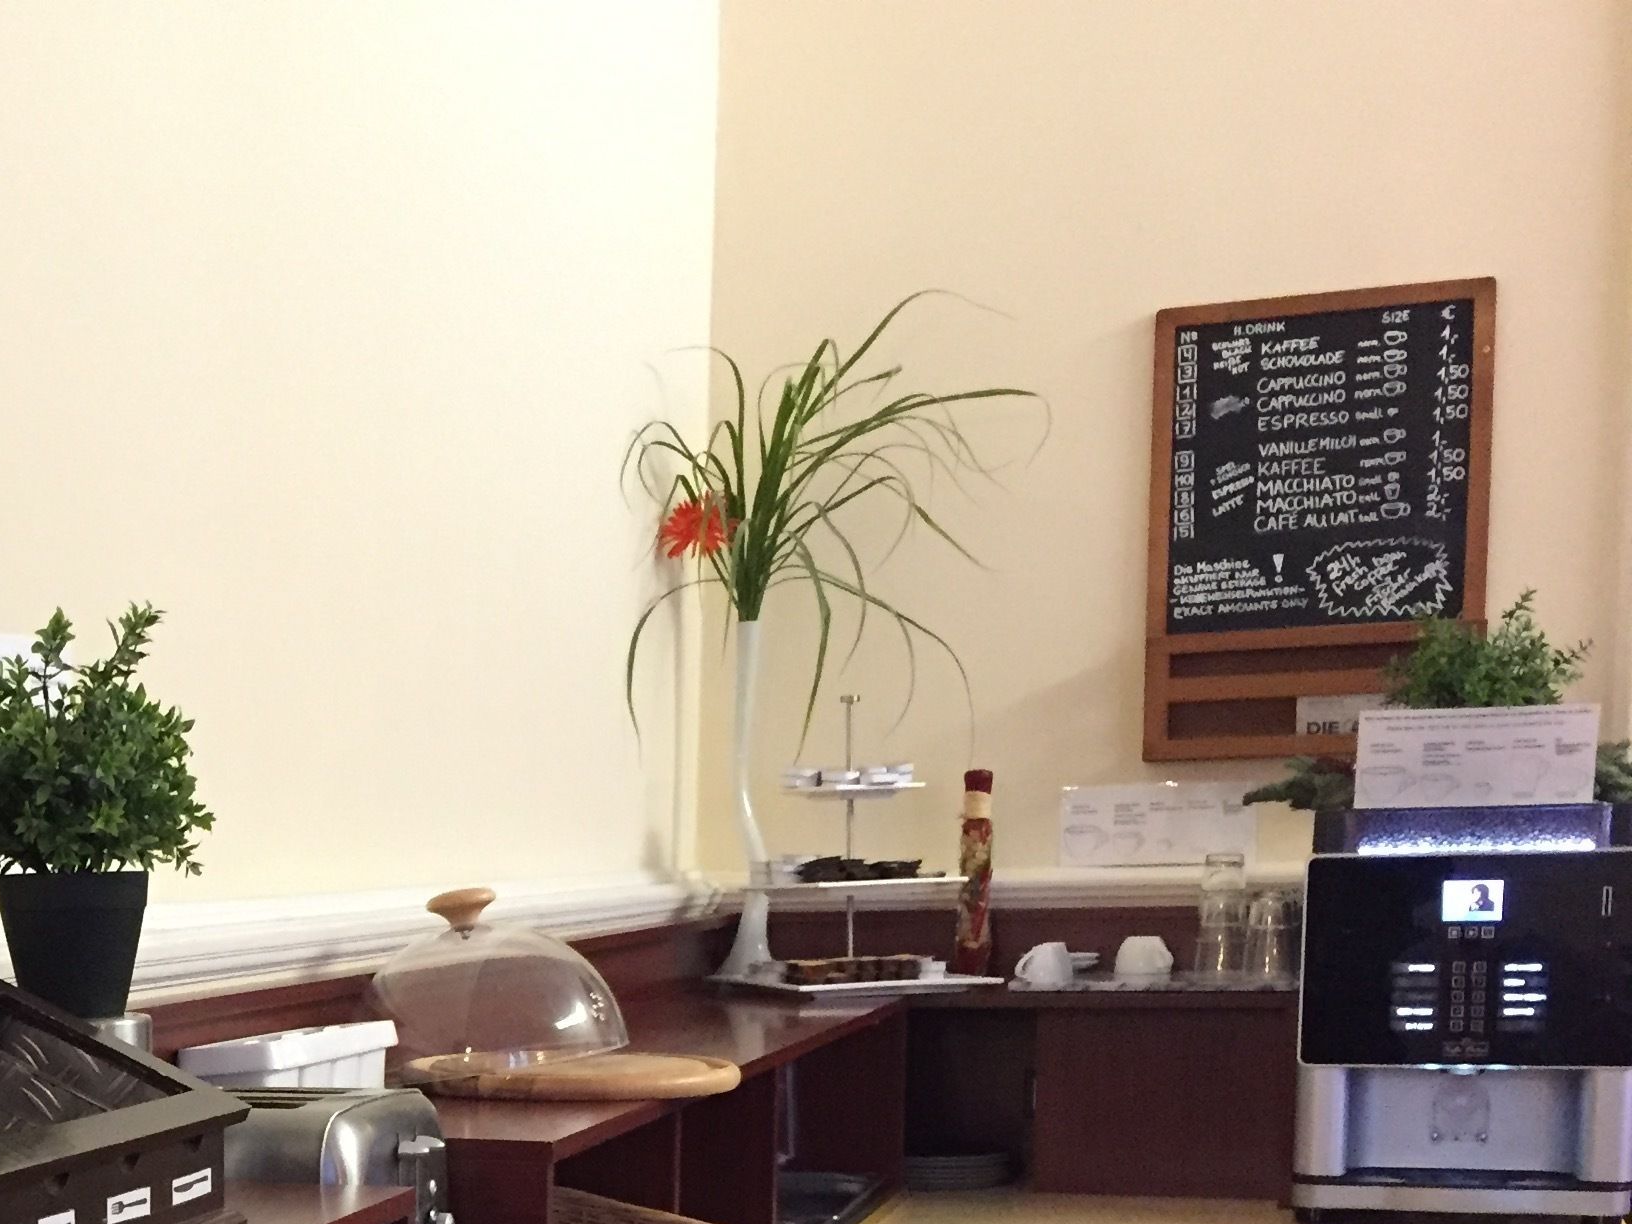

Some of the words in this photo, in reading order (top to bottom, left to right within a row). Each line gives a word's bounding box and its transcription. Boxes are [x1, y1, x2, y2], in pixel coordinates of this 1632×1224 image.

[1381, 309, 1411, 324] SIZE
[1441, 304, 1457, 320] €
[1261, 336, 1321, 355] KAFFEE
[1260, 350, 1346, 371] SCHOKOLADE
[1256, 370, 1346, 394] CAPPUCCINO
[1436, 363, 1470, 385] 1,50
[1256, 388, 1347, 413] CAPPUCCINO
[1434, 384, 1469, 404] 1,50
[1257, 411, 1350, 432] ESPRESSO
[1432, 403, 1469, 425] 1,50
[1257, 457, 1326, 477] KAFFEE
[1428, 449, 1466, 470] 1,50
[1256, 474, 1356, 497] MACCHIATO
[1426, 466, 1466, 486] 1,50
[1256, 490, 1357, 515] MACCHIATO
[1303, 513, 1328, 529] AU
[1330, 508, 1360, 526] LAIT
[1173, 604, 1214, 619] EXACT
[1217, 599, 1278, 614] AMOUNTS
[1307, 721, 1340, 735] DIE
